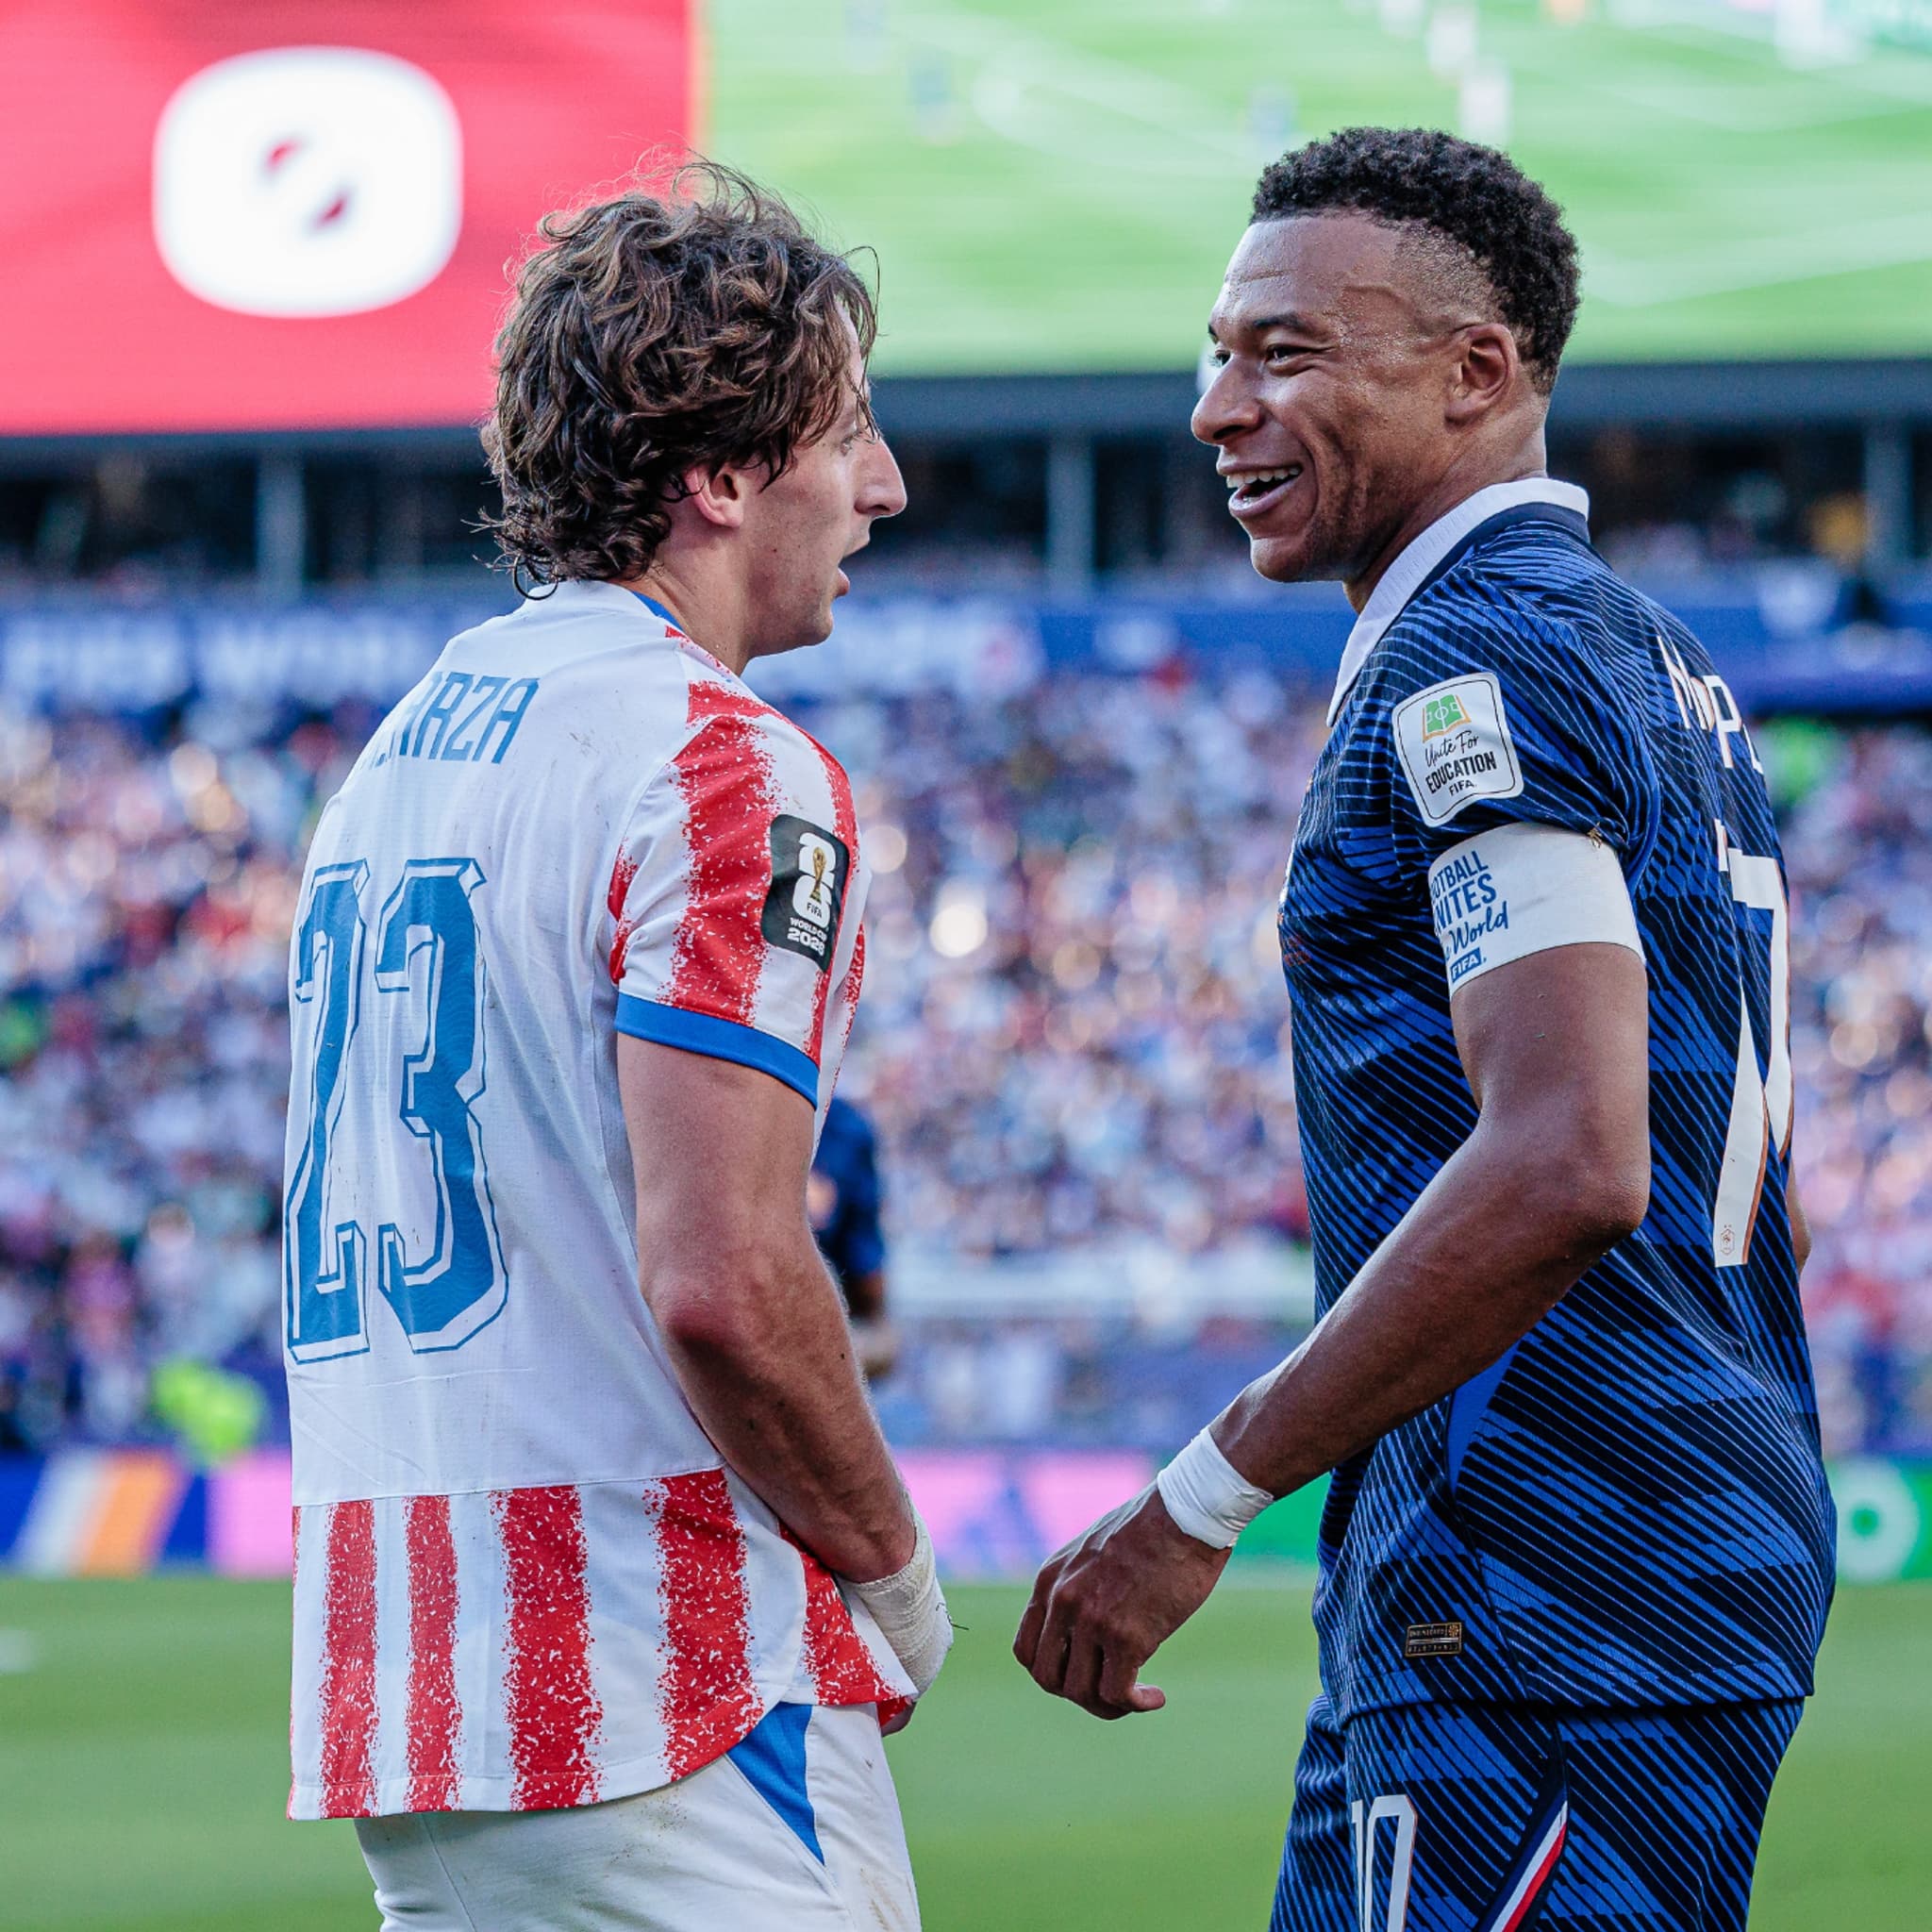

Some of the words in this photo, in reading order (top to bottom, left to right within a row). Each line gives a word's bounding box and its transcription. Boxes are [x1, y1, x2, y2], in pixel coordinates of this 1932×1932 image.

[1425, 738, 1457, 767] Unite
[1456, 730, 1479, 754] For
[1425, 751, 1497, 793] EDUCATION
[1448, 779, 1474, 796] FIFA
[1430, 850, 1489, 904] OTBALL
[807, 902, 823, 918] FIFA
[1434, 873, 1496, 934] NITES
[790, 917, 818, 936] WORLD
[1449, 901, 1508, 954] World
[1451, 951, 1480, 980] FIFA
[286, 858, 509, 1365] 23
[1352, 1794, 1418, 1932] 10
